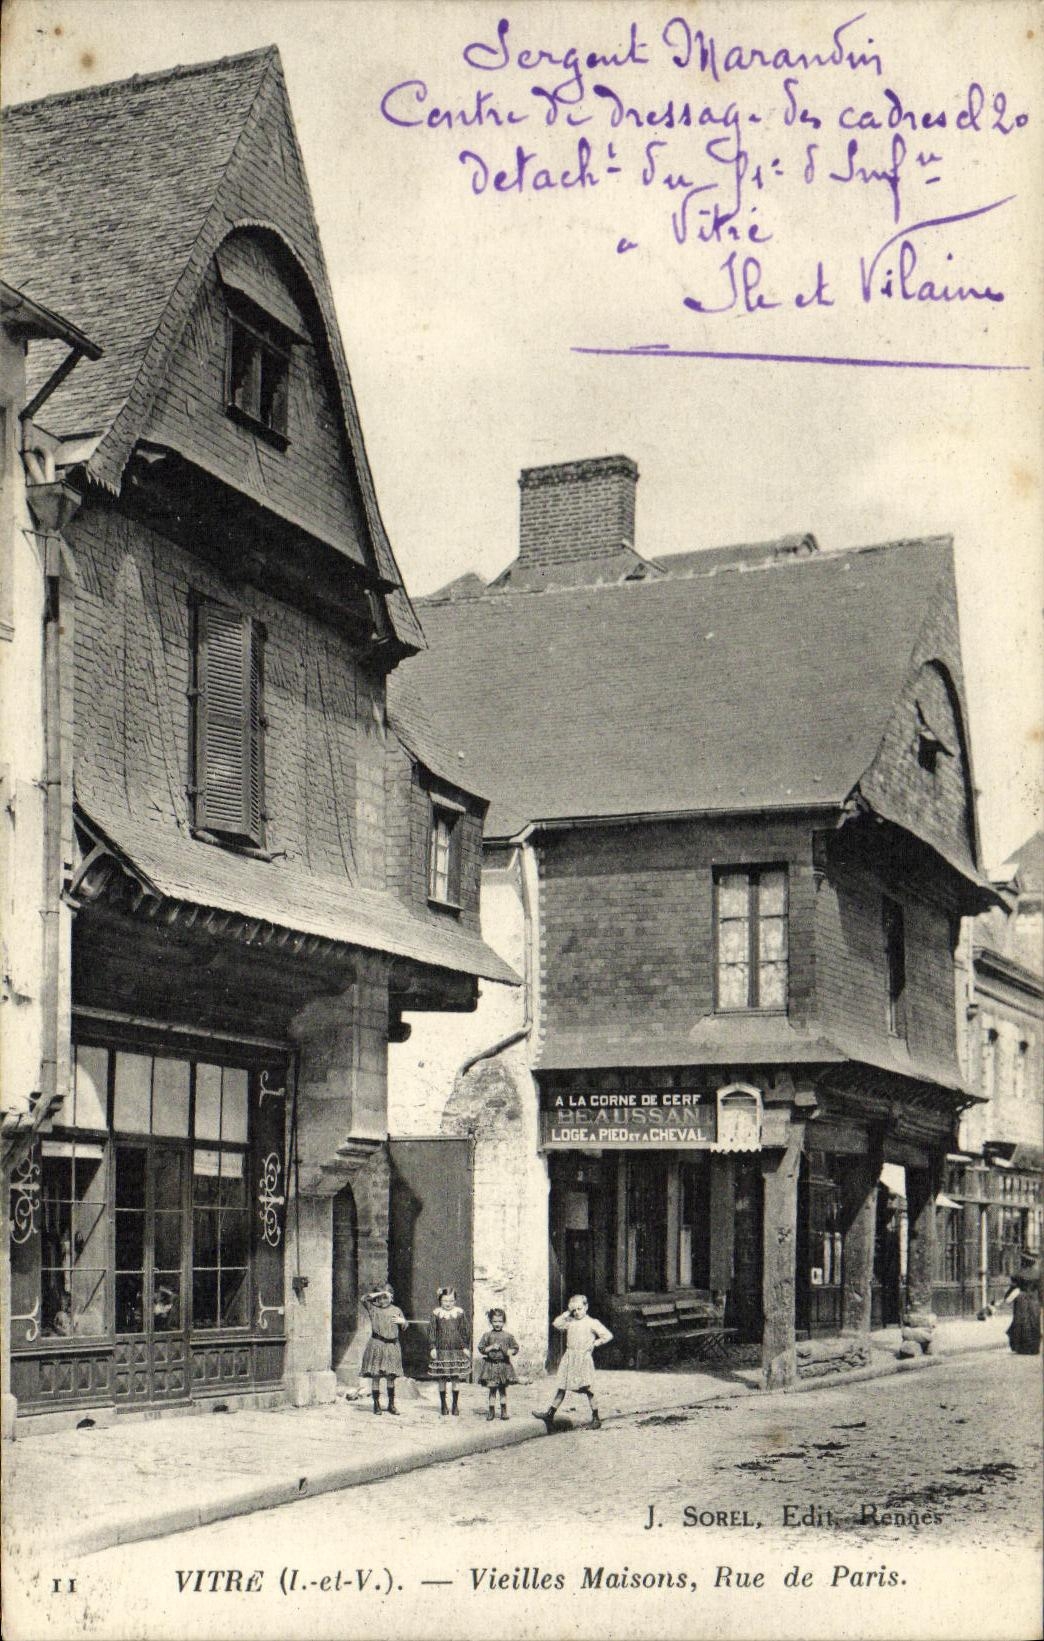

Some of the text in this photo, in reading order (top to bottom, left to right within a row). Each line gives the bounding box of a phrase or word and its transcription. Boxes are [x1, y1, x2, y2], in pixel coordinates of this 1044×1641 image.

[381, 79, 529, 129] Centre
[838, 88, 947, 131] cadres
[555, 1093, 702, 1107] A LA CORNE DE CERF
[551, 1129, 589, 1142] LOGE
[599, 1128, 629, 1142] PIED
[650, 1128, 708, 1142] CHEVAL
